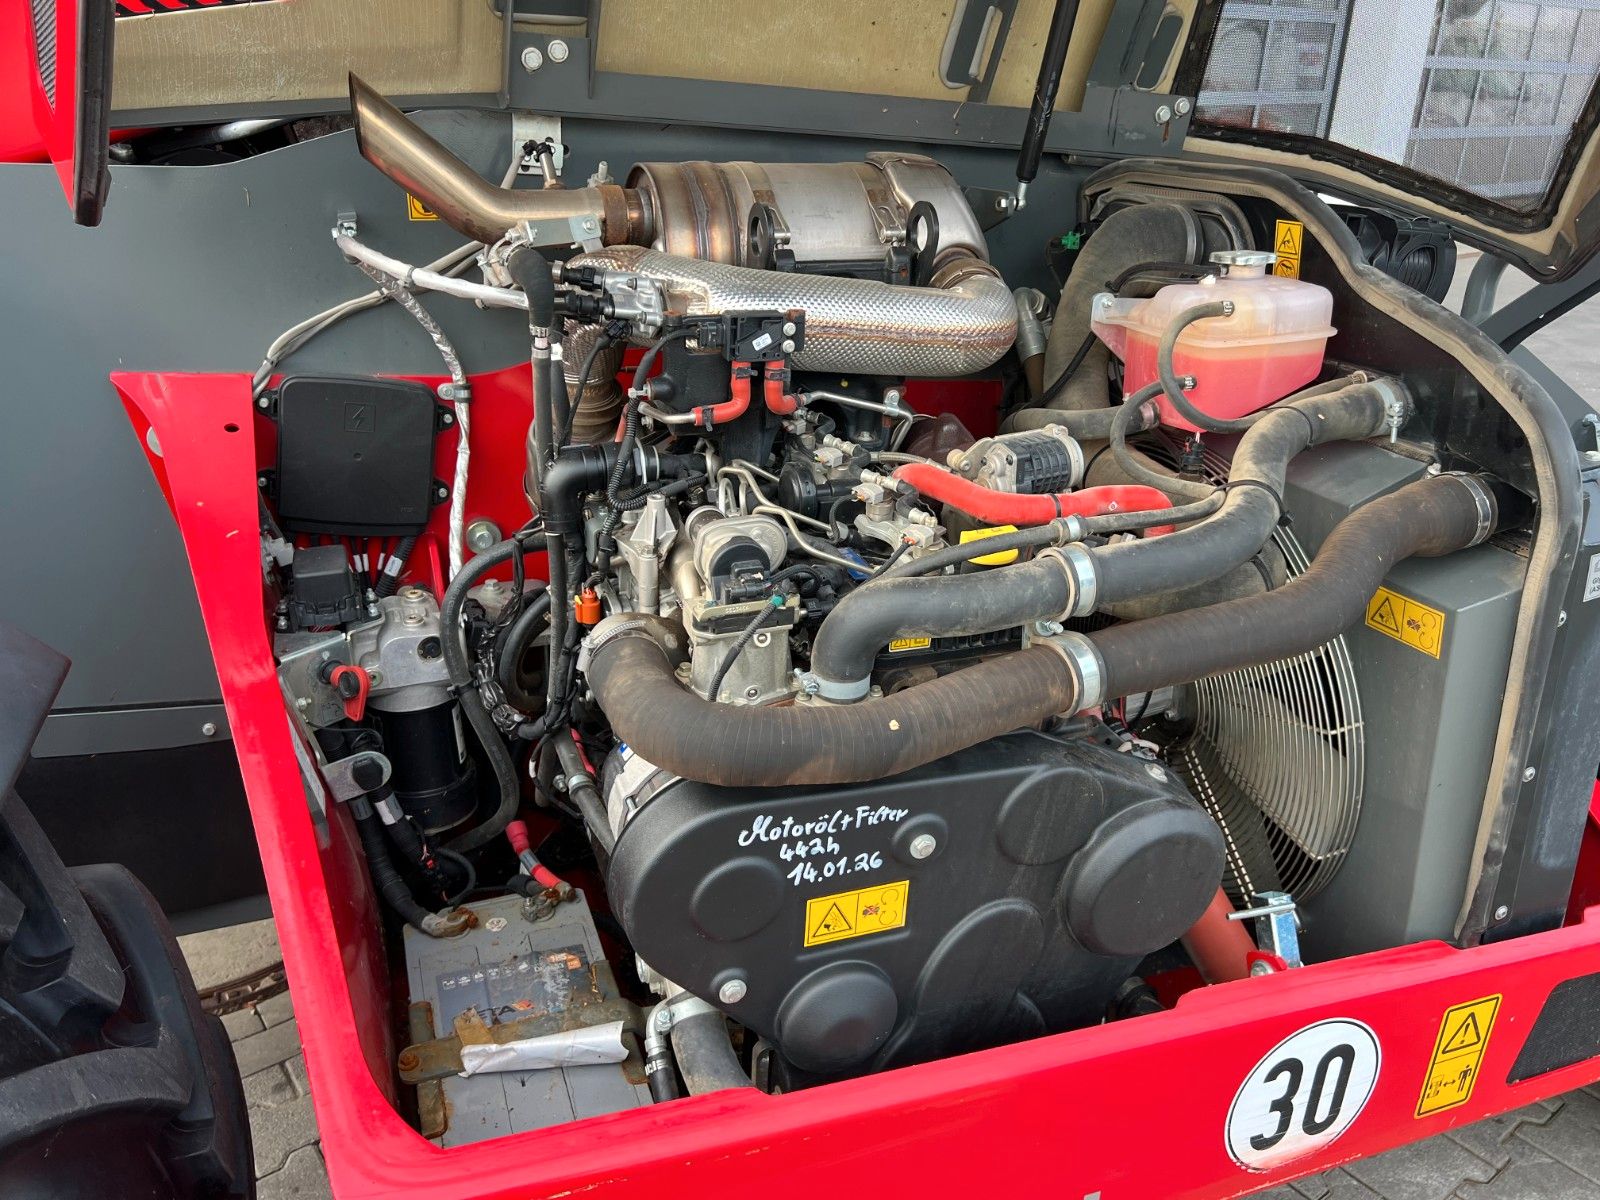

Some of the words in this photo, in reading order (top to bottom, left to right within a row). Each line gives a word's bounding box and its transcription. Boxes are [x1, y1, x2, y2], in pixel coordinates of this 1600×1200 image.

[738, 810, 842, 846] Motoröl
[856, 805, 909, 829] Filter
[780, 837, 840, 861] 442h
[787, 851, 883, 886] 14.01.26
[1249, 1043, 1356, 1151] 30
